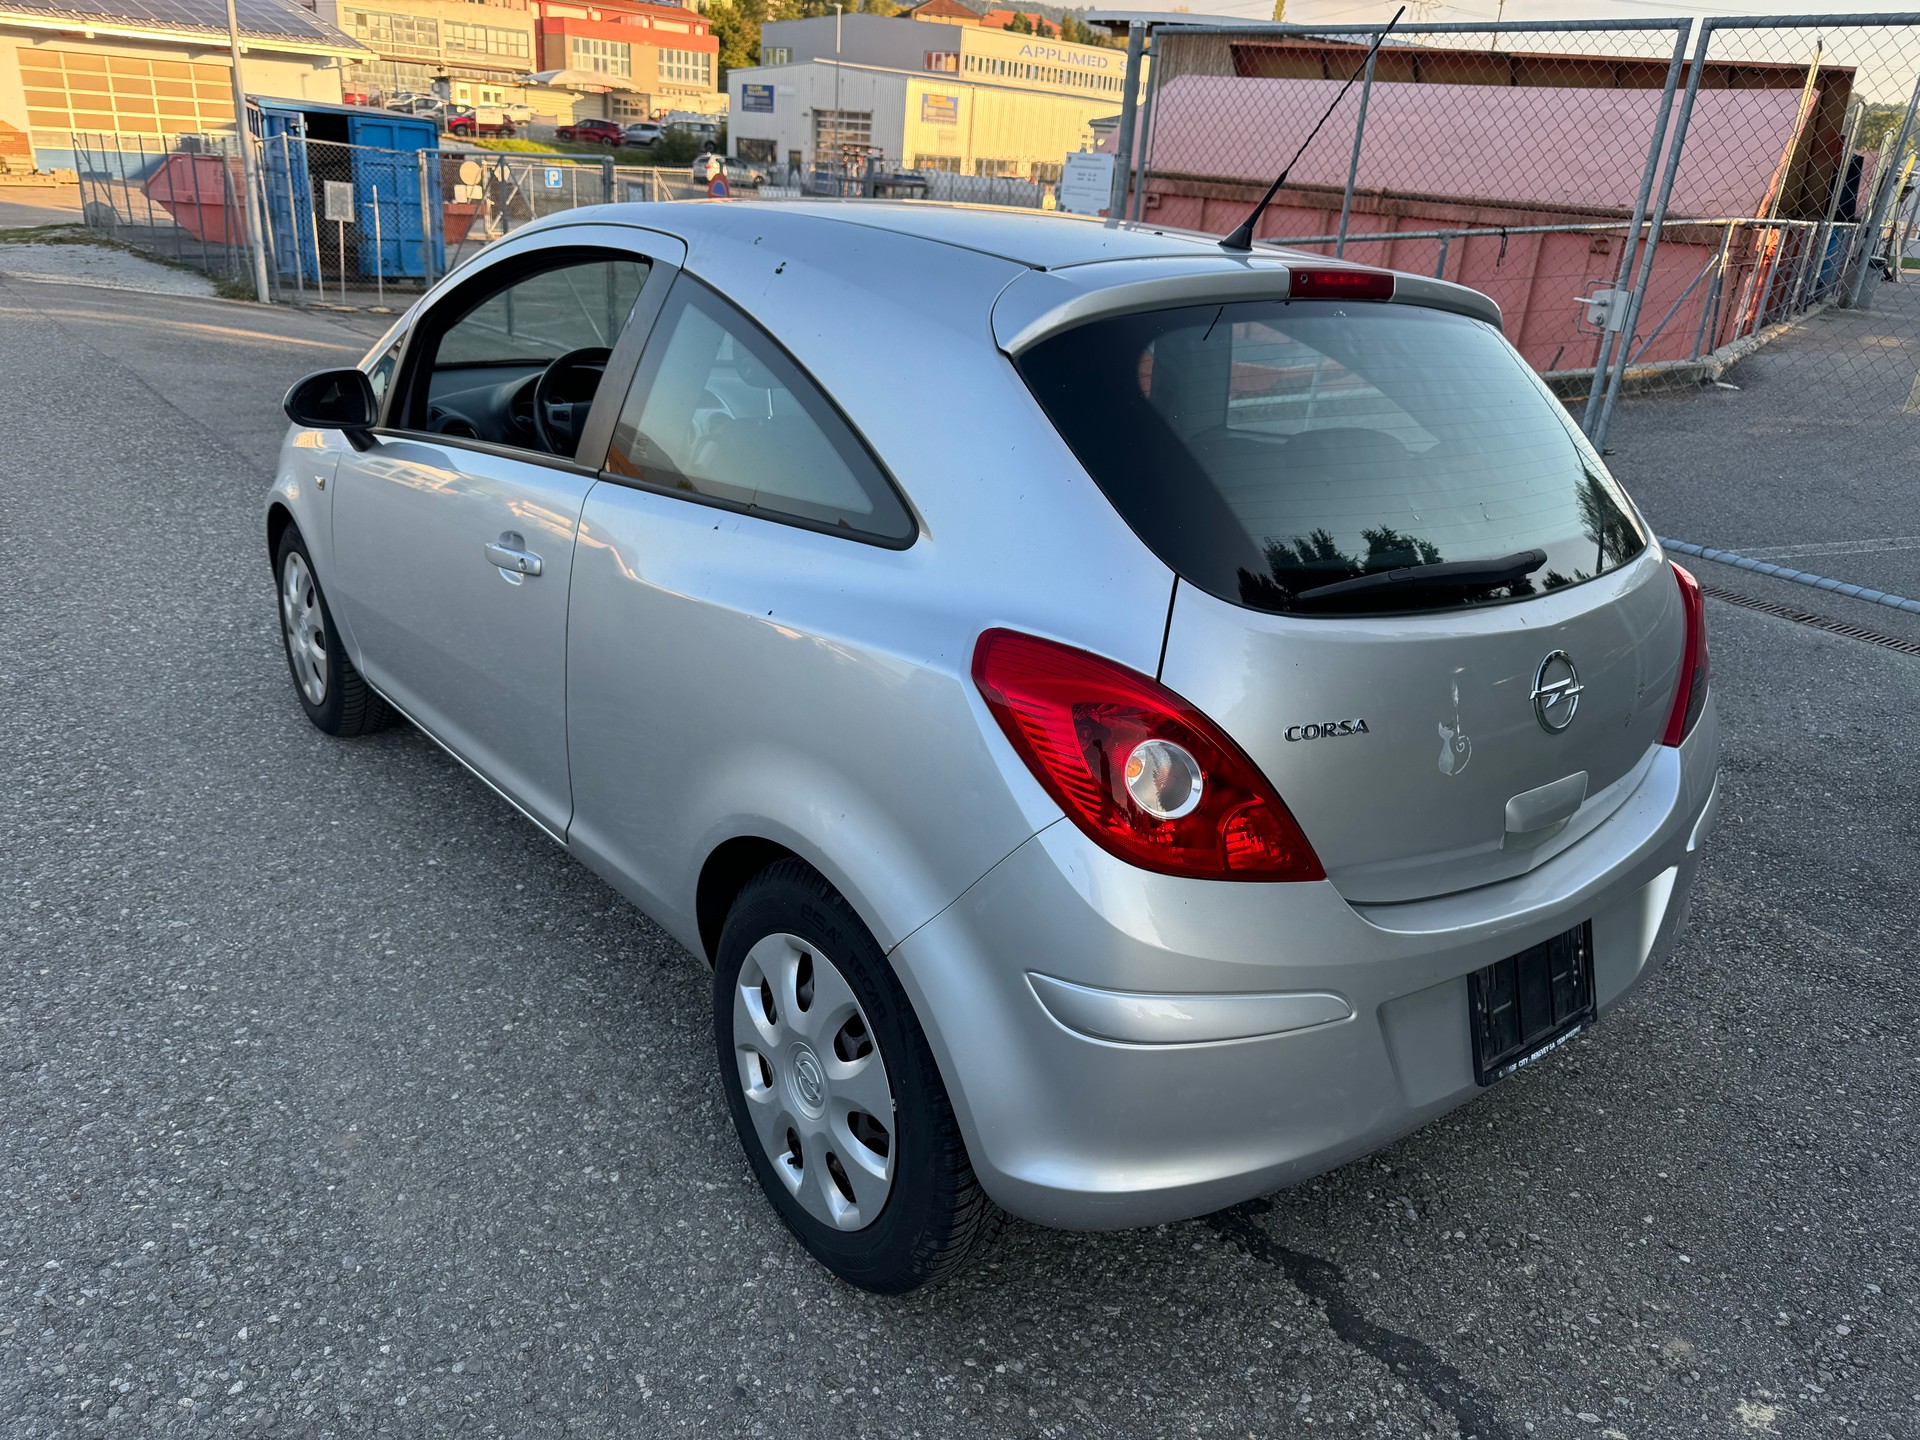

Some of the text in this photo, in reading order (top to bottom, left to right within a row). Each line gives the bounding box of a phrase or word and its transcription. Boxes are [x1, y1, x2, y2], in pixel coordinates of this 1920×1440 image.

[1018, 44, 1108, 69] APPLIMED
[549, 170, 559, 186] P
[1283, 718, 1370, 742] CORSA
[848, 948, 888, 1021] TECAR
